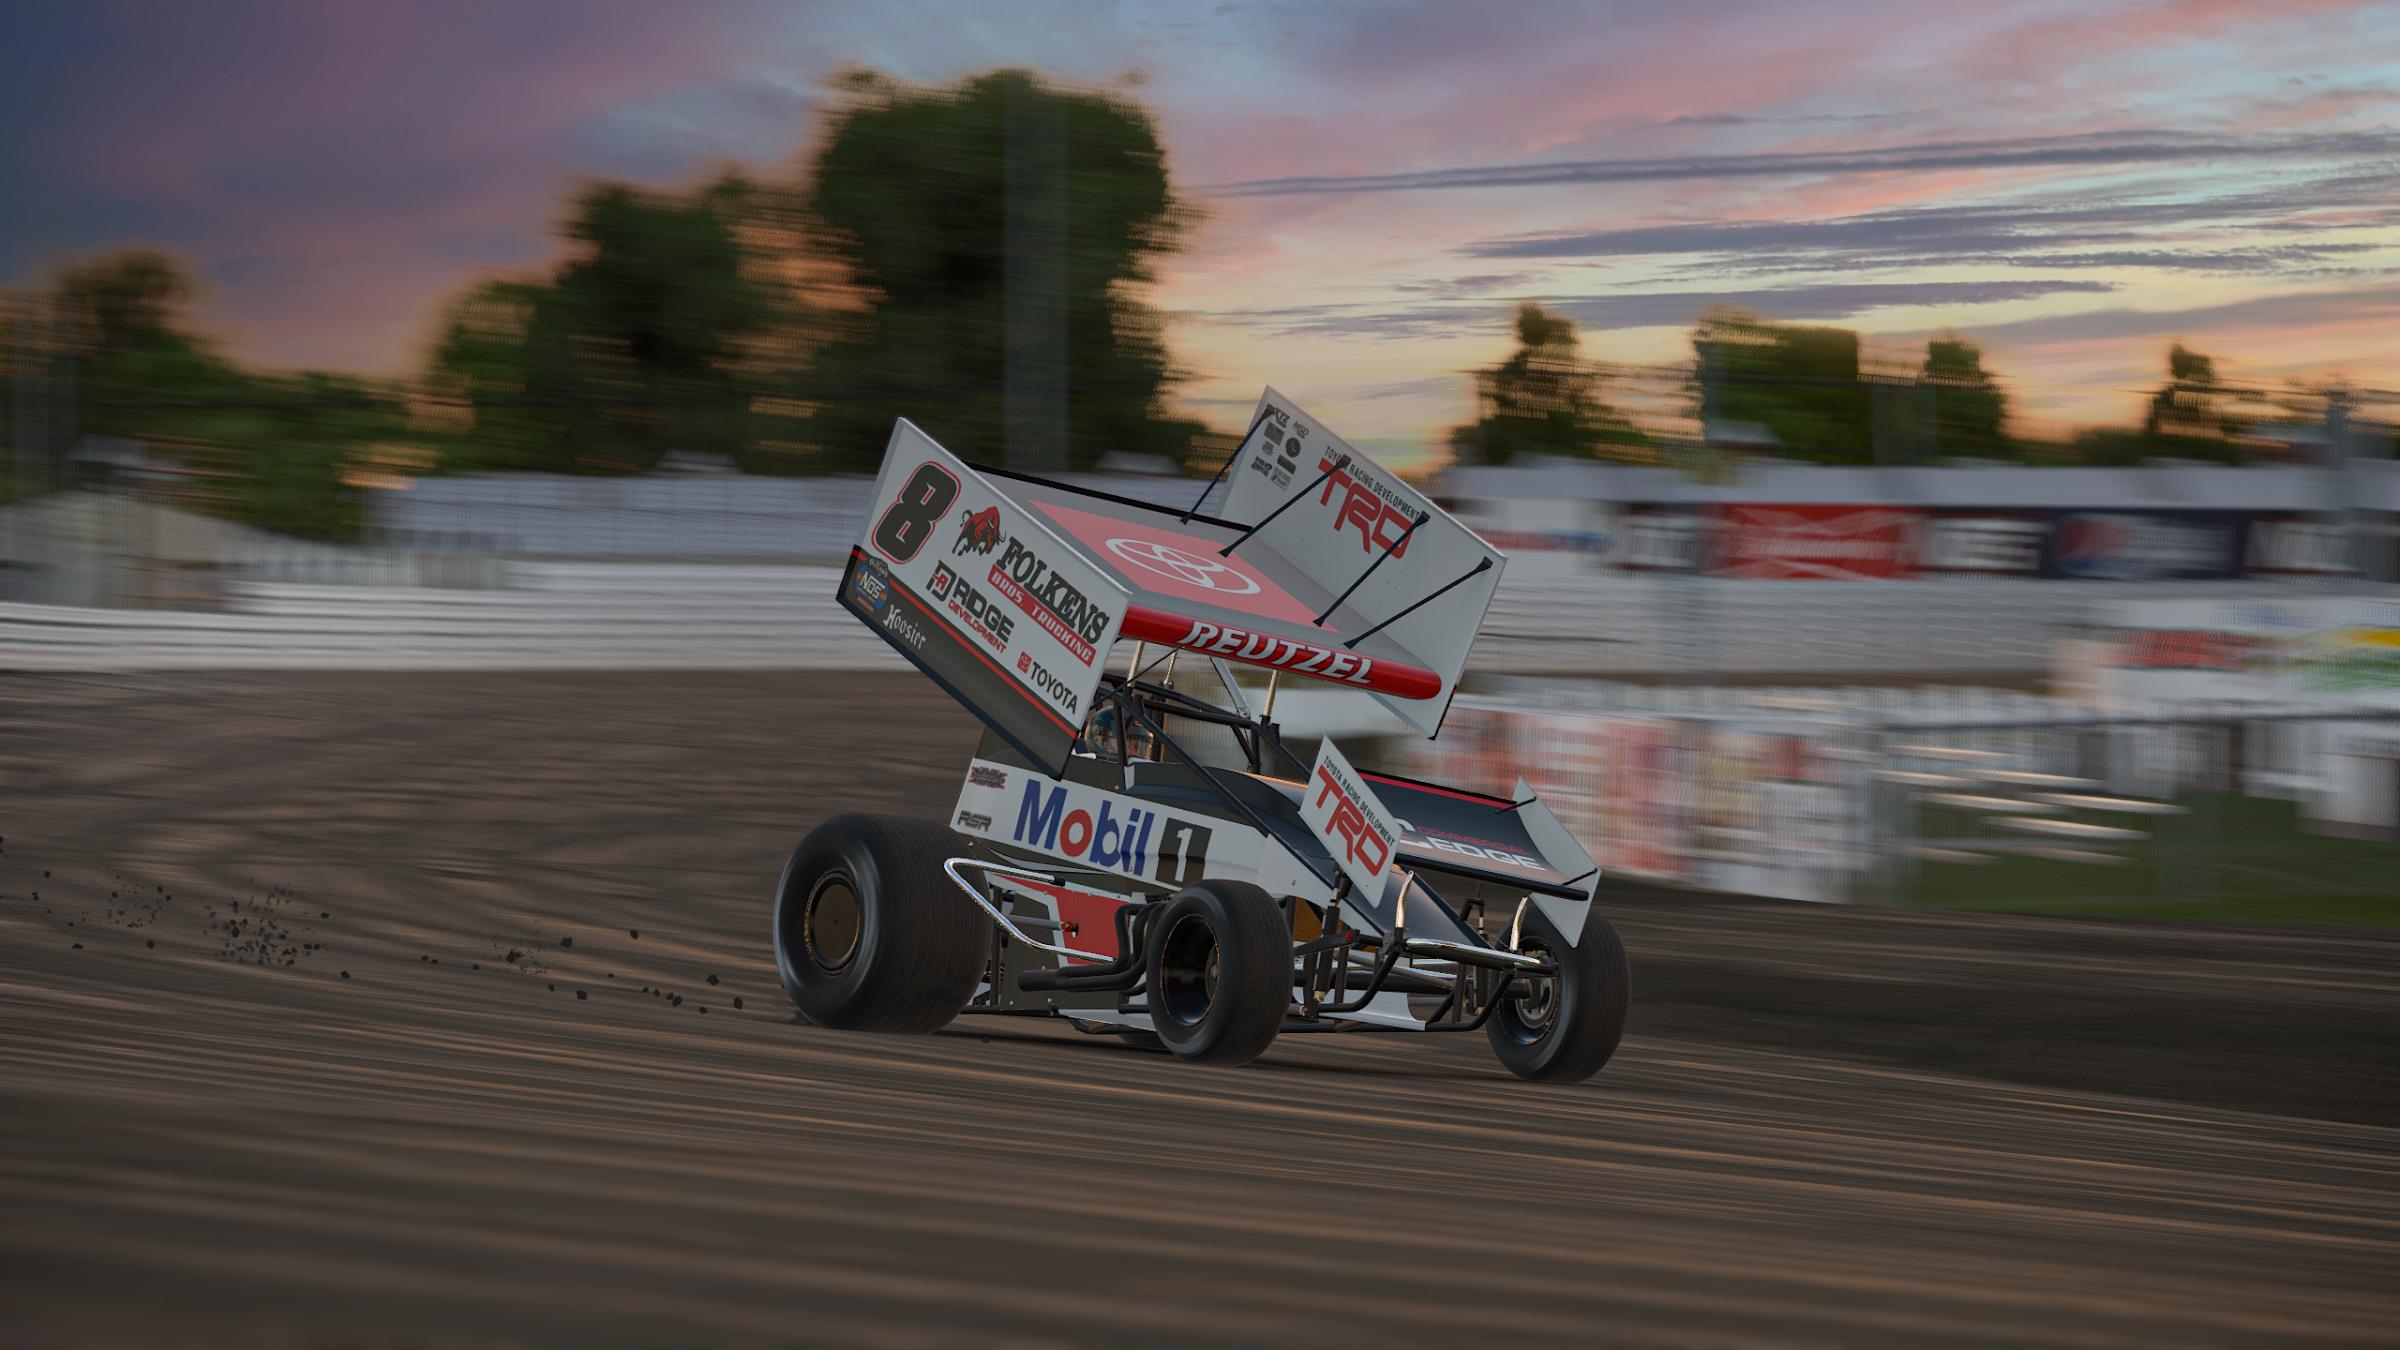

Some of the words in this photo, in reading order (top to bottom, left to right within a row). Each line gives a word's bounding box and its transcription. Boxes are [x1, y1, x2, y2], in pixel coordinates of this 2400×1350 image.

[871, 461, 961, 564] 8
[1318, 457, 1413, 559] TRD
[1350, 464, 1374, 489] RACING
[1373, 481, 1420, 521] DEVELOPMENT
[860, 571, 885, 599] NOS
[996, 536, 1110, 644] FOLKENS
[883, 604, 926, 649] Hoosier
[948, 598, 1007, 653] DEVELOPMENT
[1031, 605, 1092, 662] TRUCKING
[1178, 621, 1372, 684] REUTZEL
[1031, 661, 1078, 714] TOYOTA
[1315, 764, 1389, 877] TRD
[1323, 756, 1343, 782] TOYOTA
[1342, 777, 1361, 805] RACING
[1359, 800, 1395, 847] DEVELOPMENT
[1013, 778, 1155, 877] Mobil
[1174, 827, 1193, 883] 1
[1416, 825, 1531, 856] COMMERCIAL
[1426, 836, 1548, 872] EDGE
